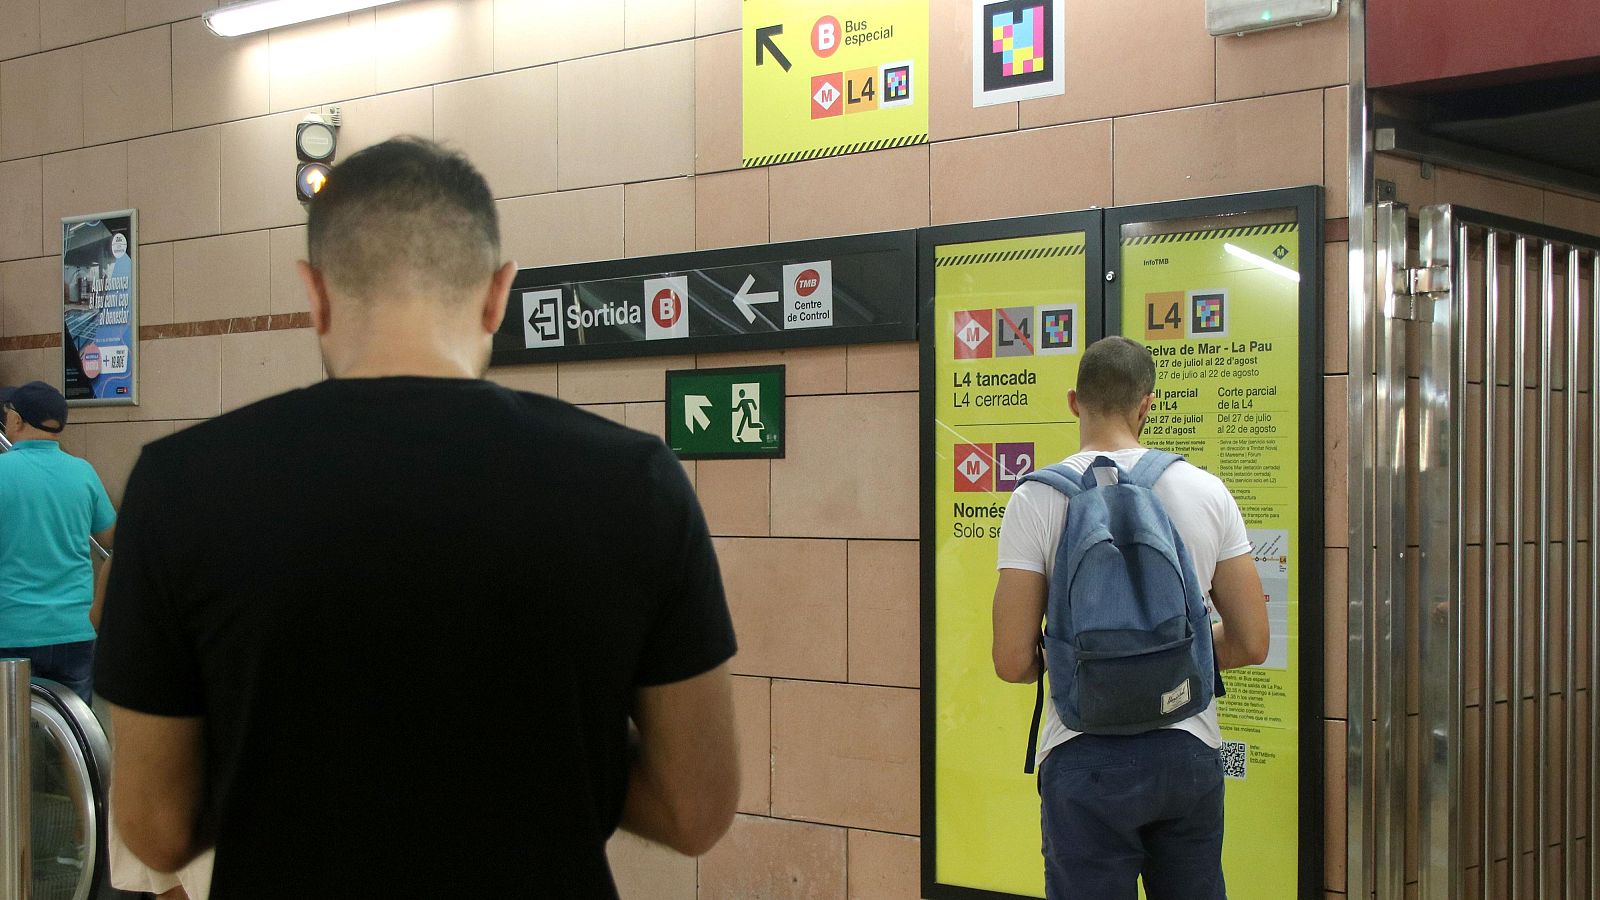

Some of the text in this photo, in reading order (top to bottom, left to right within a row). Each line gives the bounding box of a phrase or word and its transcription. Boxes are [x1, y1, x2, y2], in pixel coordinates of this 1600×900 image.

[845, 20, 867, 33] Bus
[819, 23, 834, 50] B
[845, 25, 893, 46] especial
[822, 77, 875, 104] M L4
[1144, 258, 1168, 266] InfoTMB
[798, 276, 817, 290] TMB
[660, 298, 674, 320] B
[794, 300, 822, 311] Centre
[566, 300, 641, 330] Sortida
[787, 310, 830, 322] de Control
[1148, 302, 1181, 330] L4
[966, 318, 1030, 346] M L4
[1146, 341, 1272, 356] Selva de Mar La Pau
[1184, 358, 1203, 368] juliol
[1227, 357, 1257, 366] d'agost
[954, 370, 1036, 388] L4 tancada
[1182, 371, 1198, 380] julio
[1200, 370, 1206, 378] al
[1233, 369, 1259, 378] agosto
[954, 390, 1028, 408] L4 cerrada
[1165, 388, 1198, 400] parcial
[1218, 386, 1276, 398] Corte parcial
[1218, 400, 1253, 409] de la L4
[1146, 416, 1157, 424] Del
[1172, 415, 1181, 423] de
[1184, 415, 1203, 424] juliol
[1218, 414, 1230, 422] Del
[1232, 414, 1241, 422] 27
[1256, 413, 1271, 423] julio
[1144, 426, 1196, 435] al 22 d'agost
[1226, 425, 1235, 433] 22
[1238, 425, 1247, 433] de
[1250, 425, 1276, 435] agosto
[966, 454, 1031, 481] M L2
[954, 502, 1006, 518] Només
[954, 523, 984, 538] Solo
